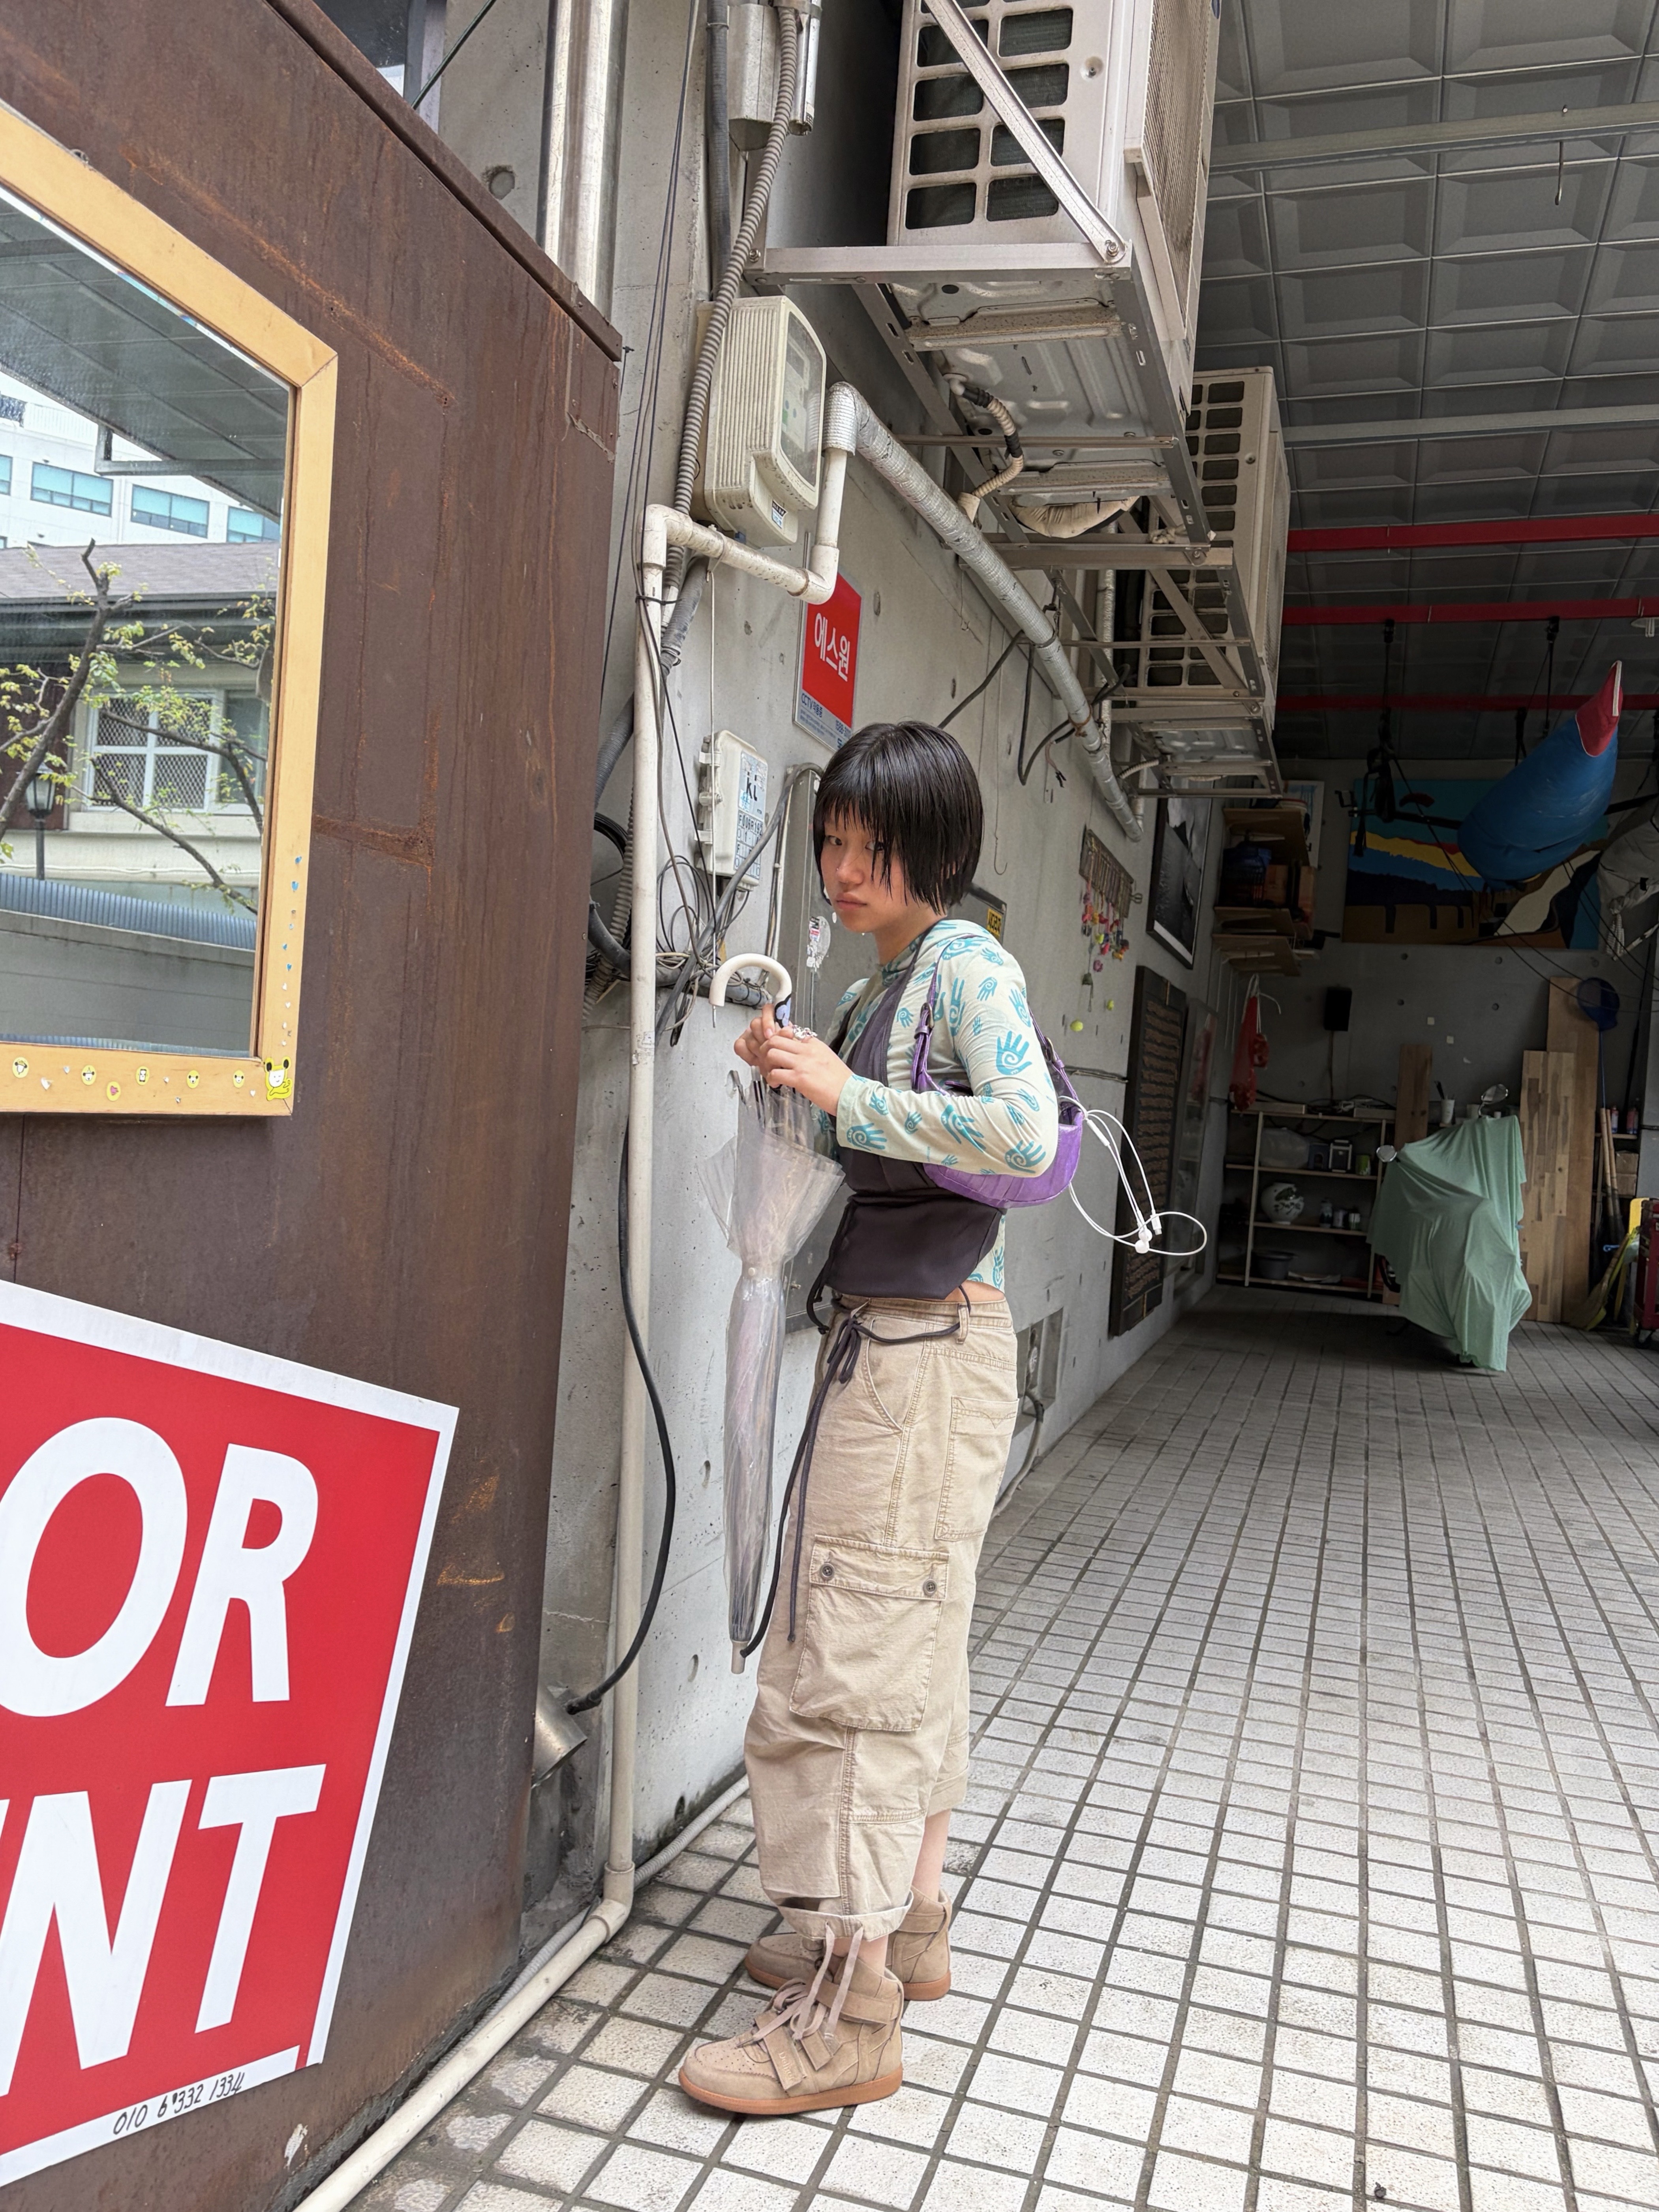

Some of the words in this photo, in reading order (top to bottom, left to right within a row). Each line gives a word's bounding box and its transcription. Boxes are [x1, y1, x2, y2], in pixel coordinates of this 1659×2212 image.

[814, 613, 851, 682] 에스원
[0, 1417, 319, 1717] OR
[0, 1764, 327, 2096] NT
[113, 2104, 148, 2135] 010
